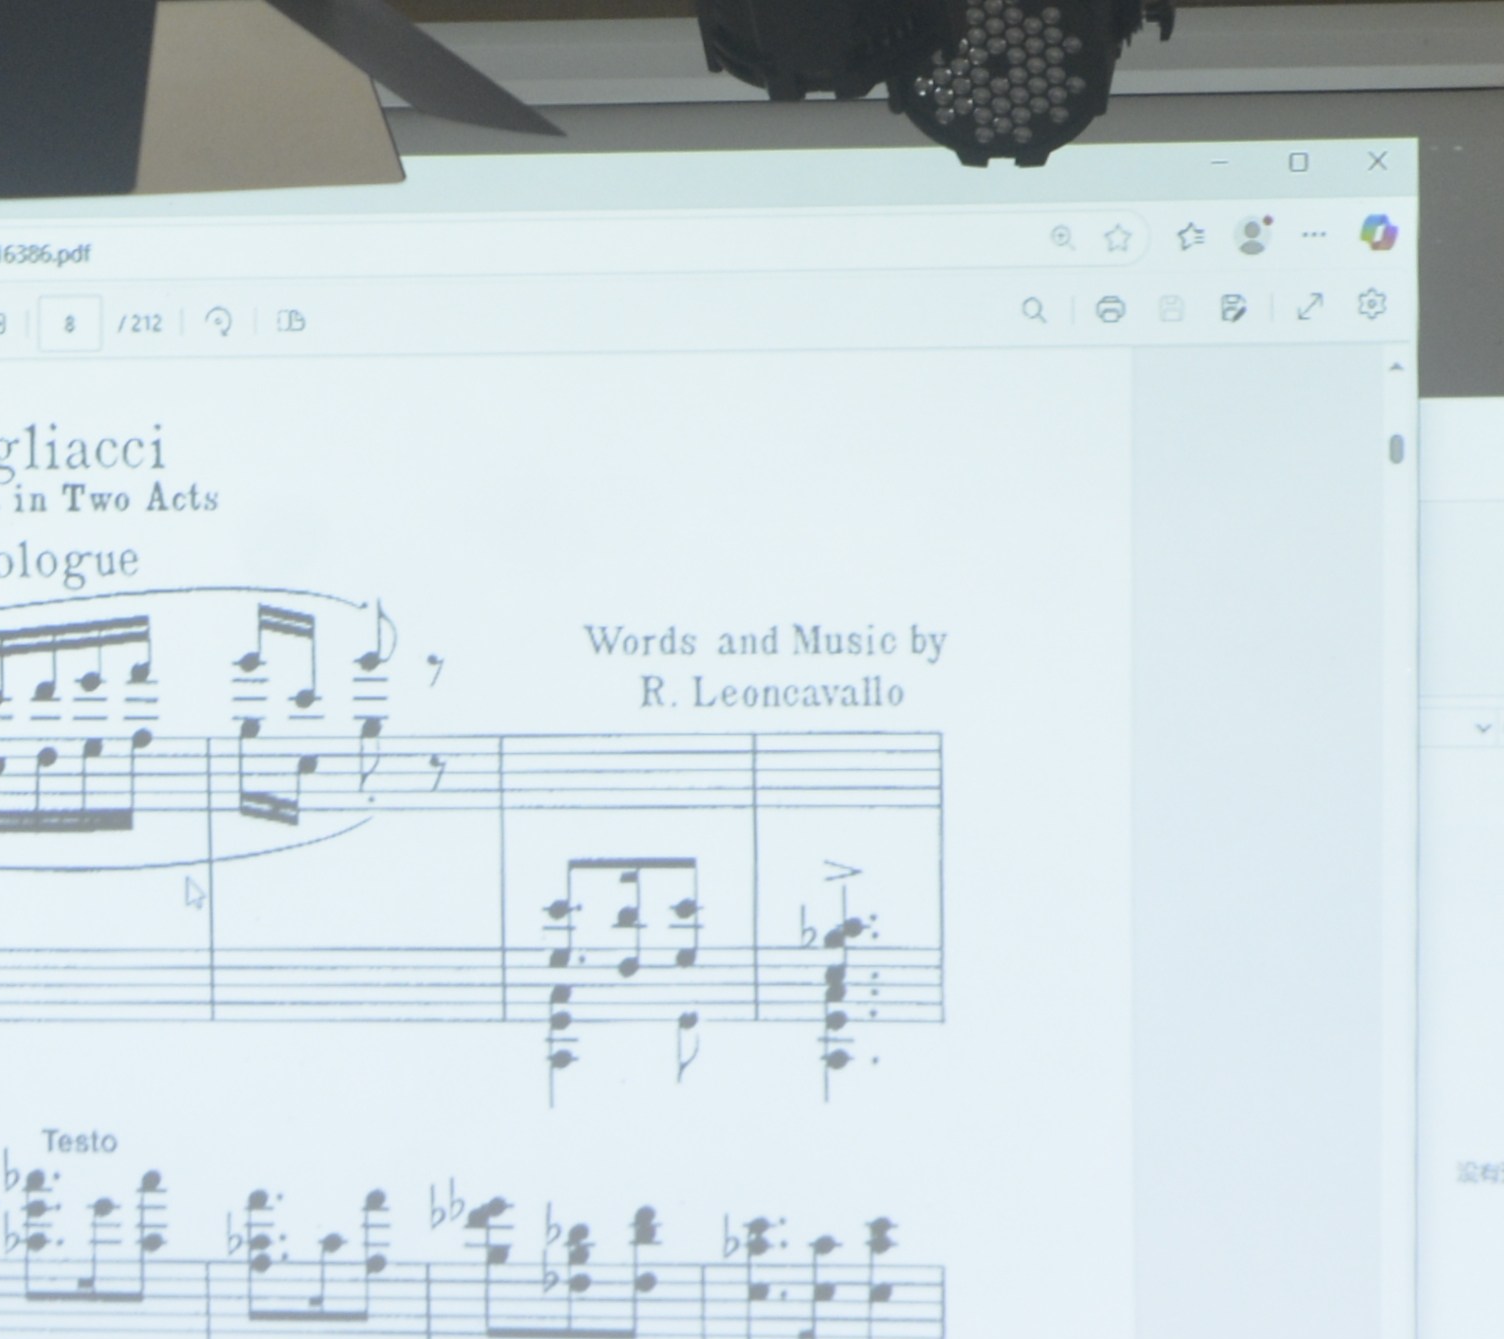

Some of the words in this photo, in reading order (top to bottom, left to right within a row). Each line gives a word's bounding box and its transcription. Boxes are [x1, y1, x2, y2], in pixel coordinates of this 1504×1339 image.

[13, 483, 47, 514] in
[61, 482, 131, 513] Two
[145, 480, 220, 512] Acts
[584, 624, 698, 656] Words
[716, 624, 780, 656] and
[792, 623, 898, 656] Music
[910, 623, 948, 664] by
[639, 674, 677, 709] R.
[693, 673, 906, 709] Leoncavallo
[42, 1128, 119, 1154] Testo
